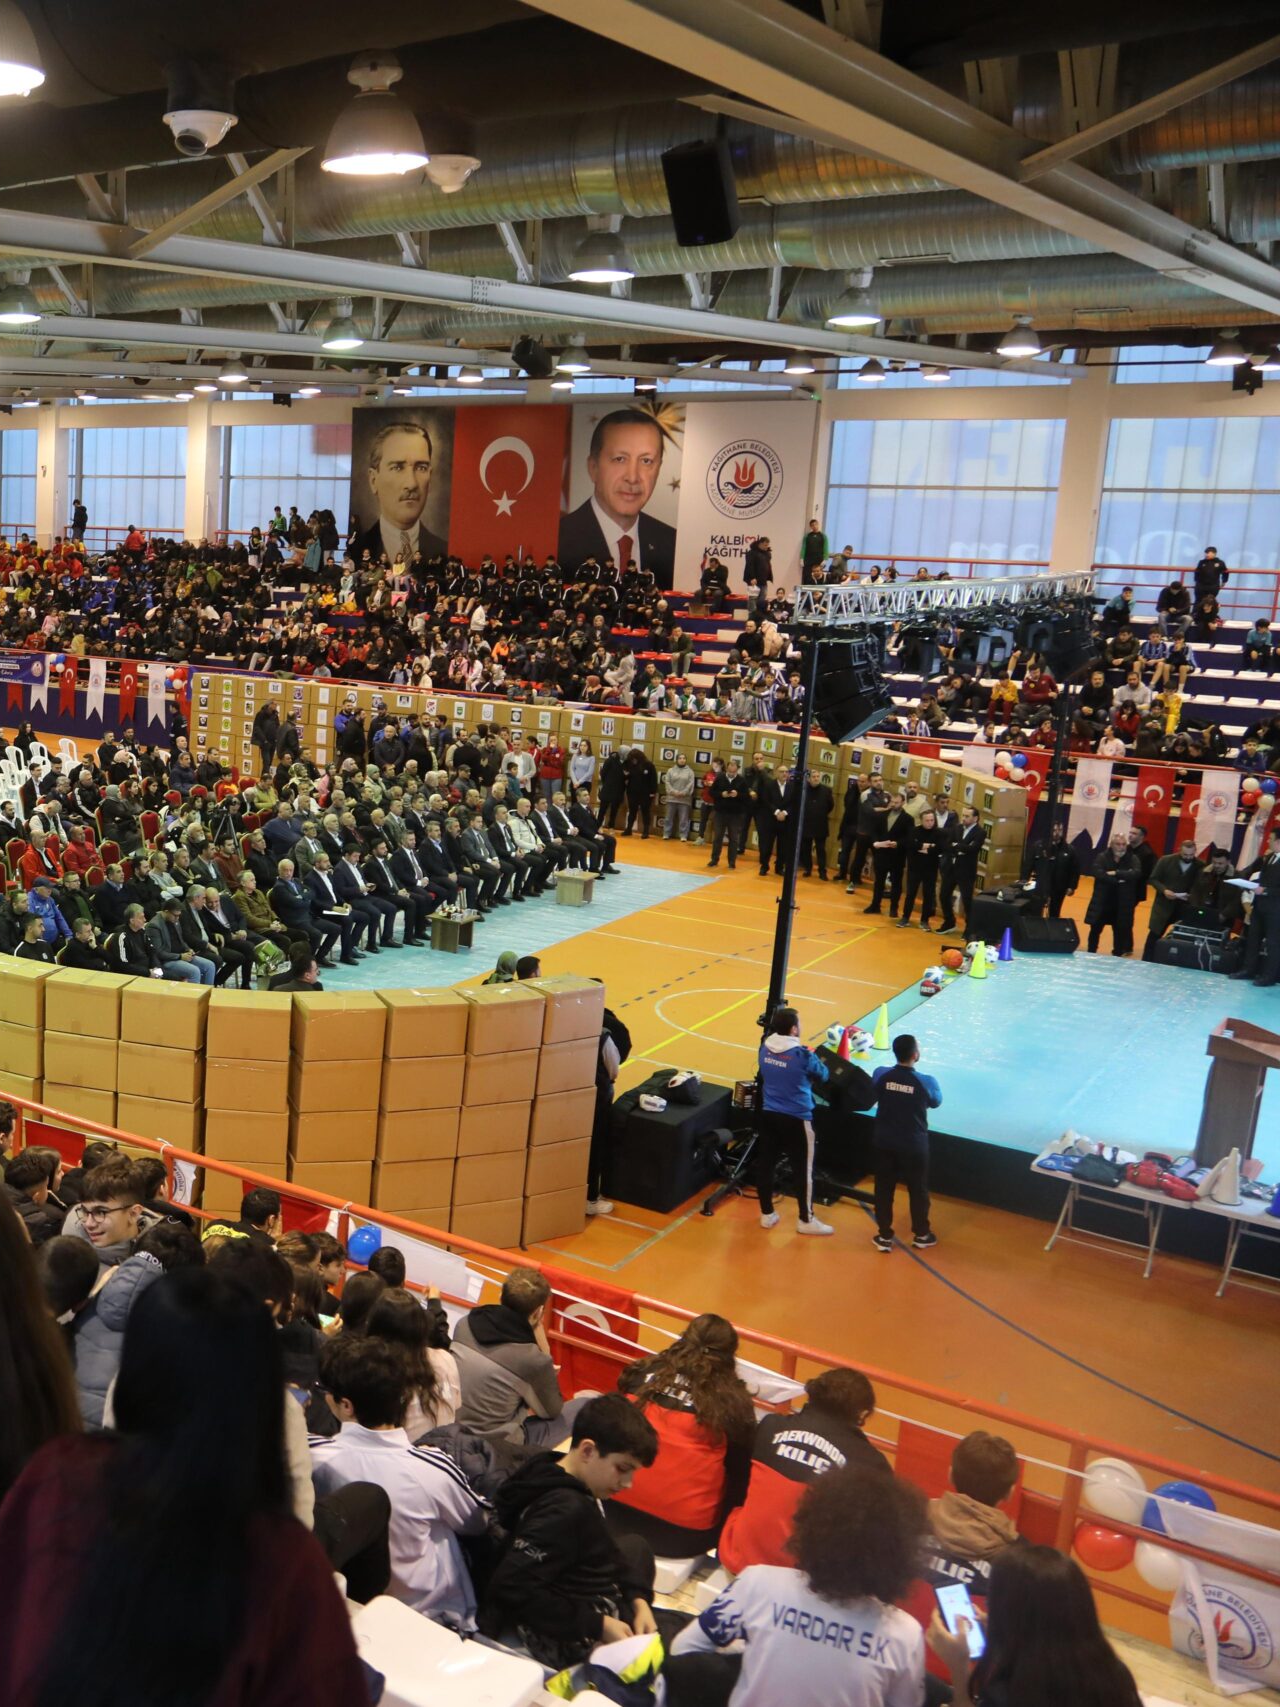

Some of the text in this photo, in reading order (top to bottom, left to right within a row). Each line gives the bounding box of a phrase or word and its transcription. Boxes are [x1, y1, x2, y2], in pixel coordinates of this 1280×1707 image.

[885, 1081, 915, 1095] EĞİTMEN
[772, 1430, 847, 1469] TAEKWONDO
[776, 1443, 832, 1475] KILIÇ
[772, 1602, 855, 1653] VARDAR
